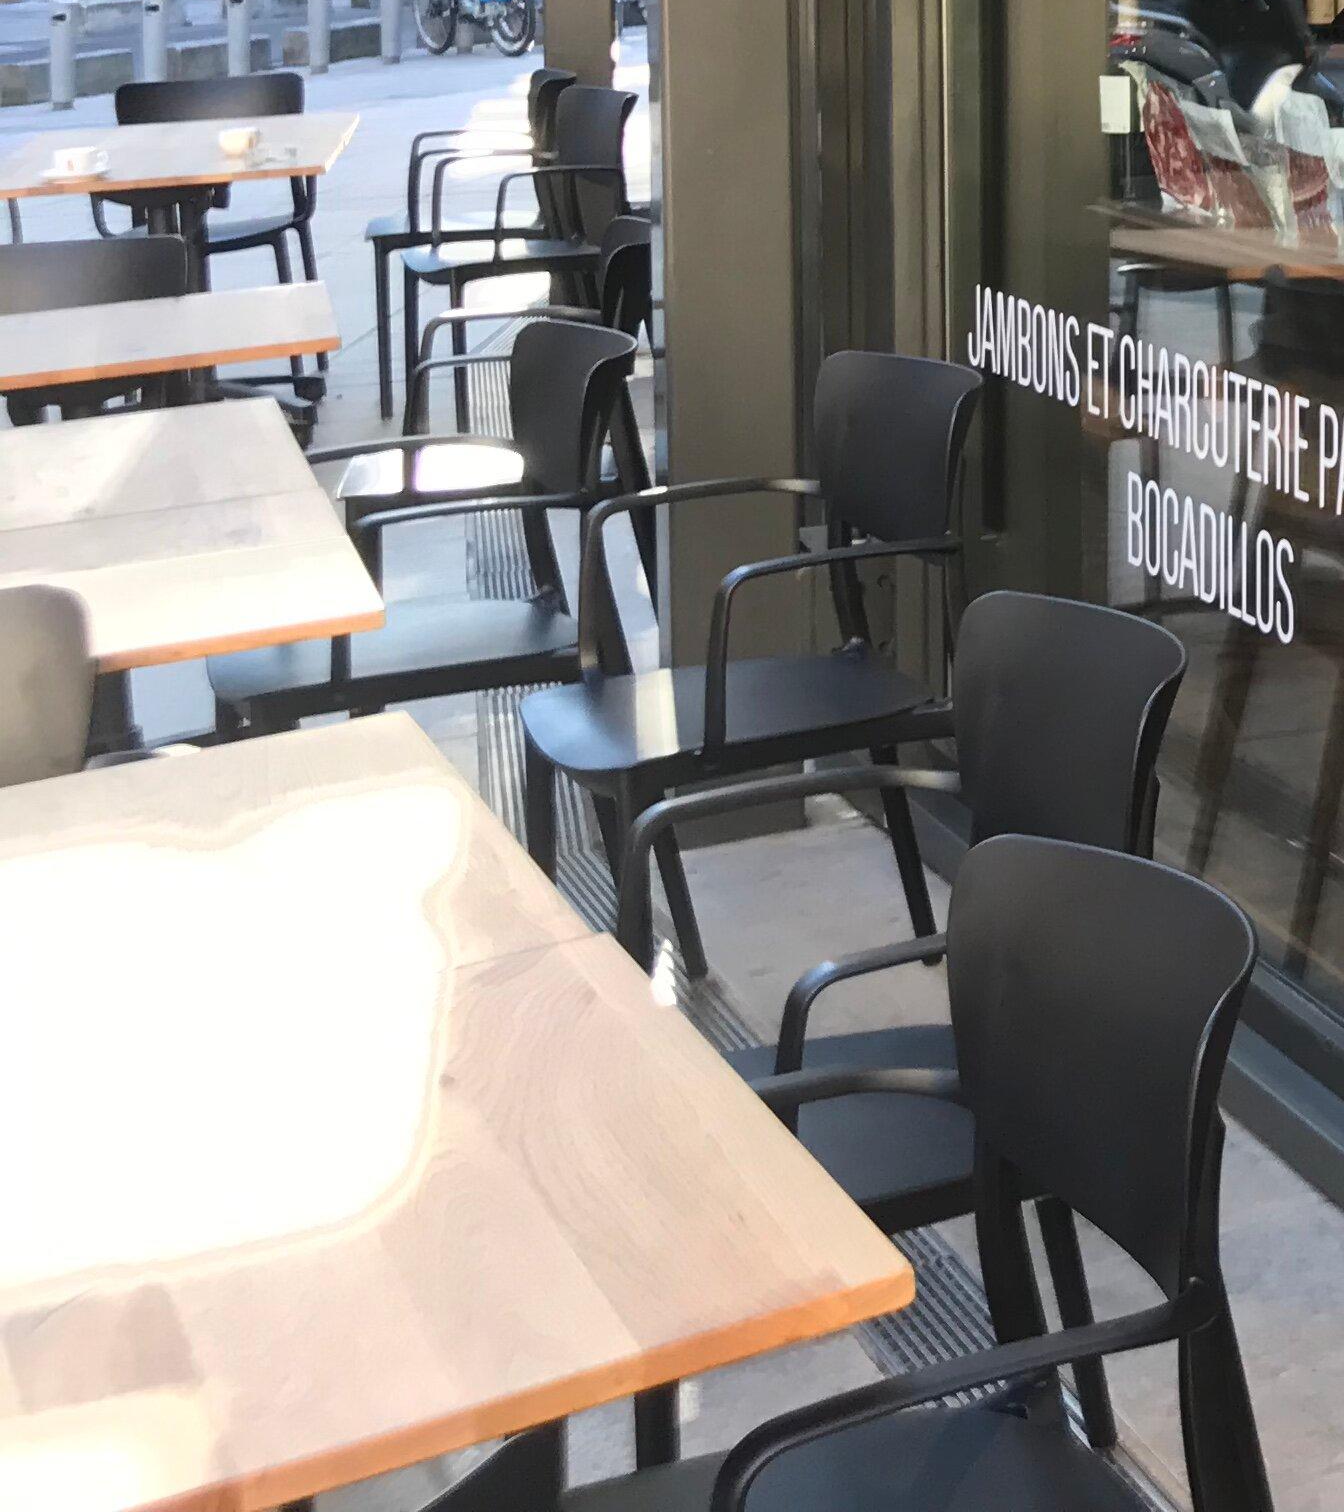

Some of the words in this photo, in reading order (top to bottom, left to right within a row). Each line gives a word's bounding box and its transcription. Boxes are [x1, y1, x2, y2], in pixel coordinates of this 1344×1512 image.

[967, 283, 1080, 407] JAMBONS
[1086, 321, 1115, 420] ET
[1118, 333, 1311, 503] CHARCUTERIE
[1127, 471, 1295, 645] BOCADILLOS
